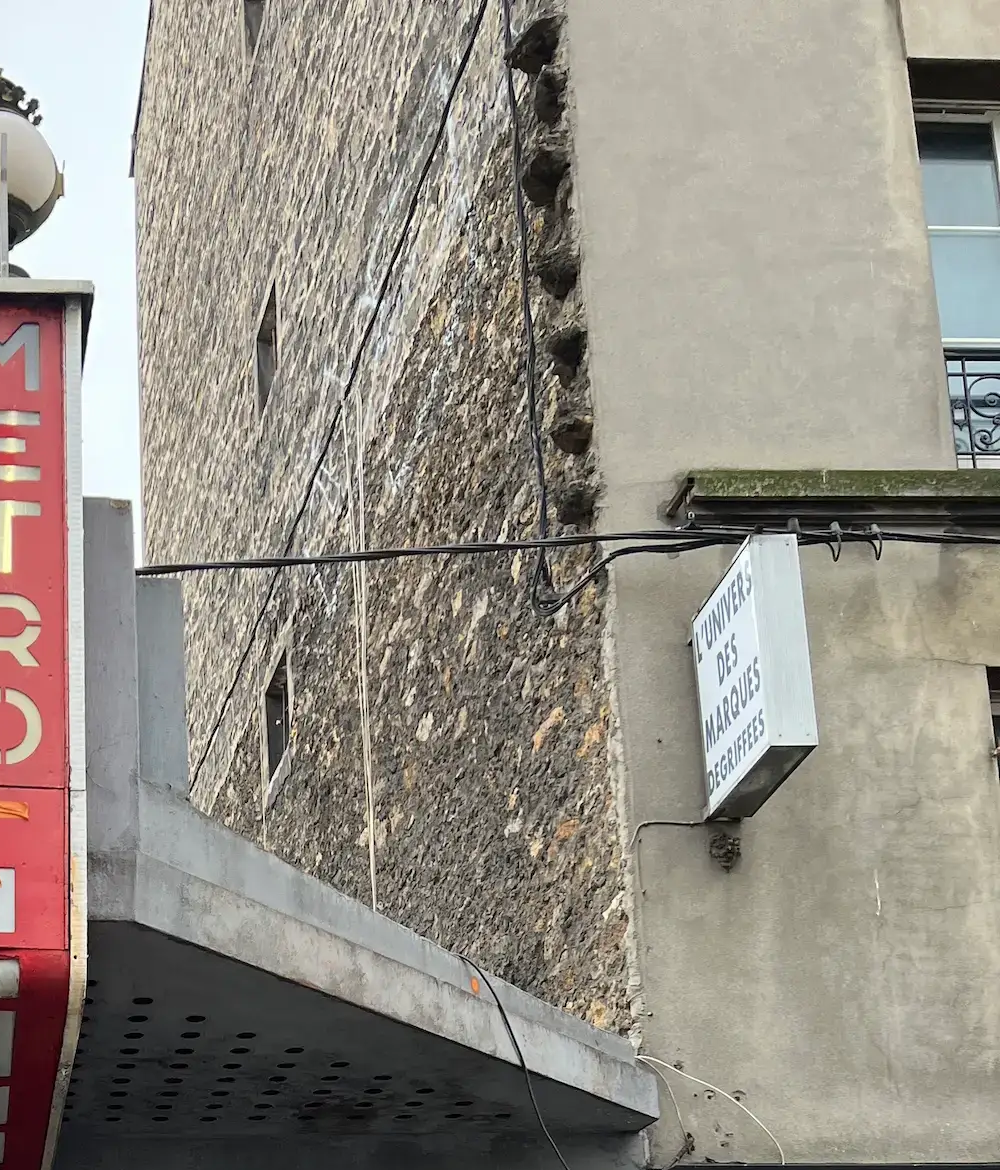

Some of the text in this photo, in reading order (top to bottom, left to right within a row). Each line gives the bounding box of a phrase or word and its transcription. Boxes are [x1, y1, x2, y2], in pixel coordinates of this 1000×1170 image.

[694, 559, 752, 664] L'UNIVERS
[703, 655, 761, 753] MARQUES
[716, 632, 738, 687] DES
[707, 708, 765, 797] DEGRIFFEES
